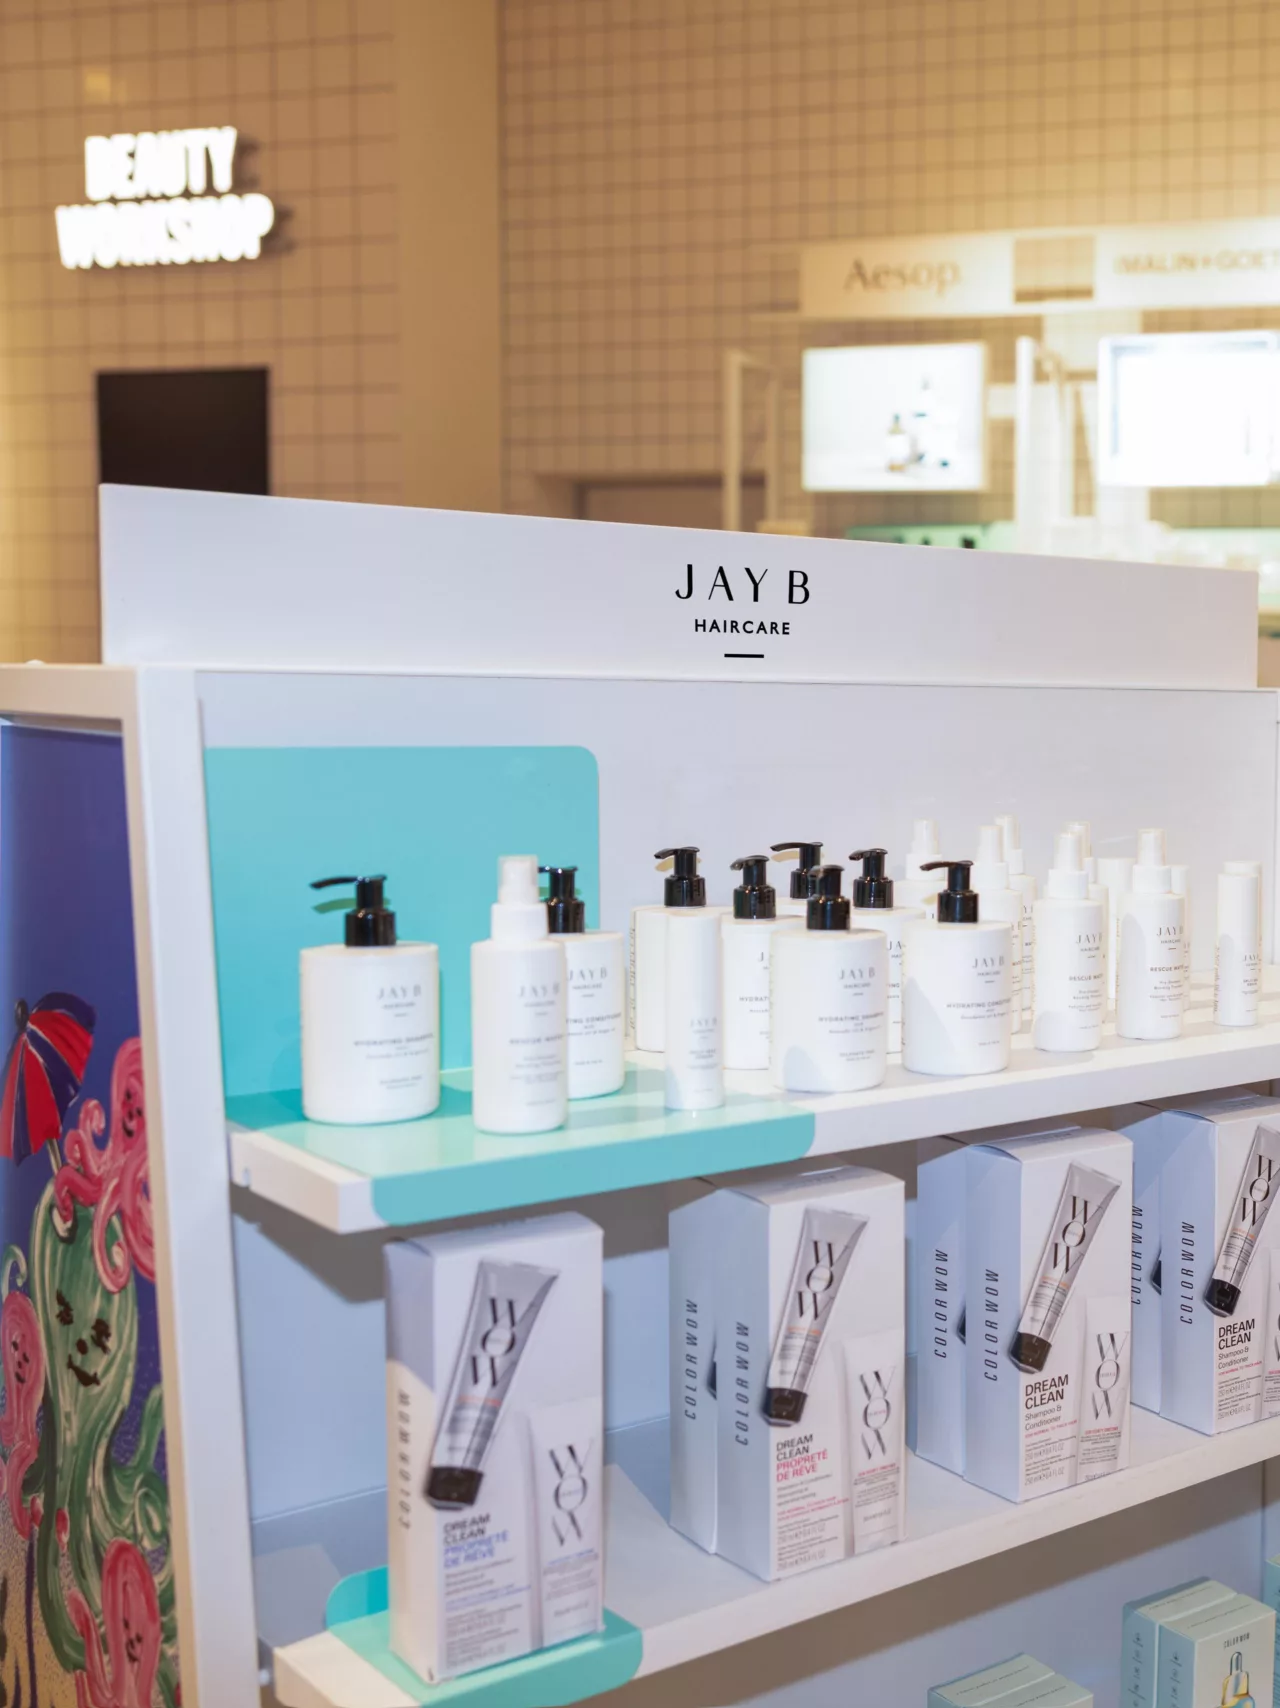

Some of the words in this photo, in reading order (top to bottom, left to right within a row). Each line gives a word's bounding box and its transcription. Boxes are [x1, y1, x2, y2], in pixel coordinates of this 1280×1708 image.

[843, 255, 961, 295] Aesop
[694, 618, 790, 635] HAIRCARE
[1052, 1195, 1103, 1274] WOW
[1218, 1319, 1255, 1339] DREAM
[1218, 1332, 1251, 1350] CLEAN
[1218, 1349, 1243, 1361] Shampoo
[1218, 1356, 1249, 1370] Conditioner
[1025, 1374, 1069, 1397] DREAM
[1025, 1388, 1064, 1410] CLEAN
[1025, 1407, 1055, 1421] Shampoo
[1025, 1415, 1061, 1431] Conditioner
[776, 1434, 814, 1452] DREAM
[776, 1445, 810, 1462] CLEAN
[776, 1469, 790, 1483] DE
